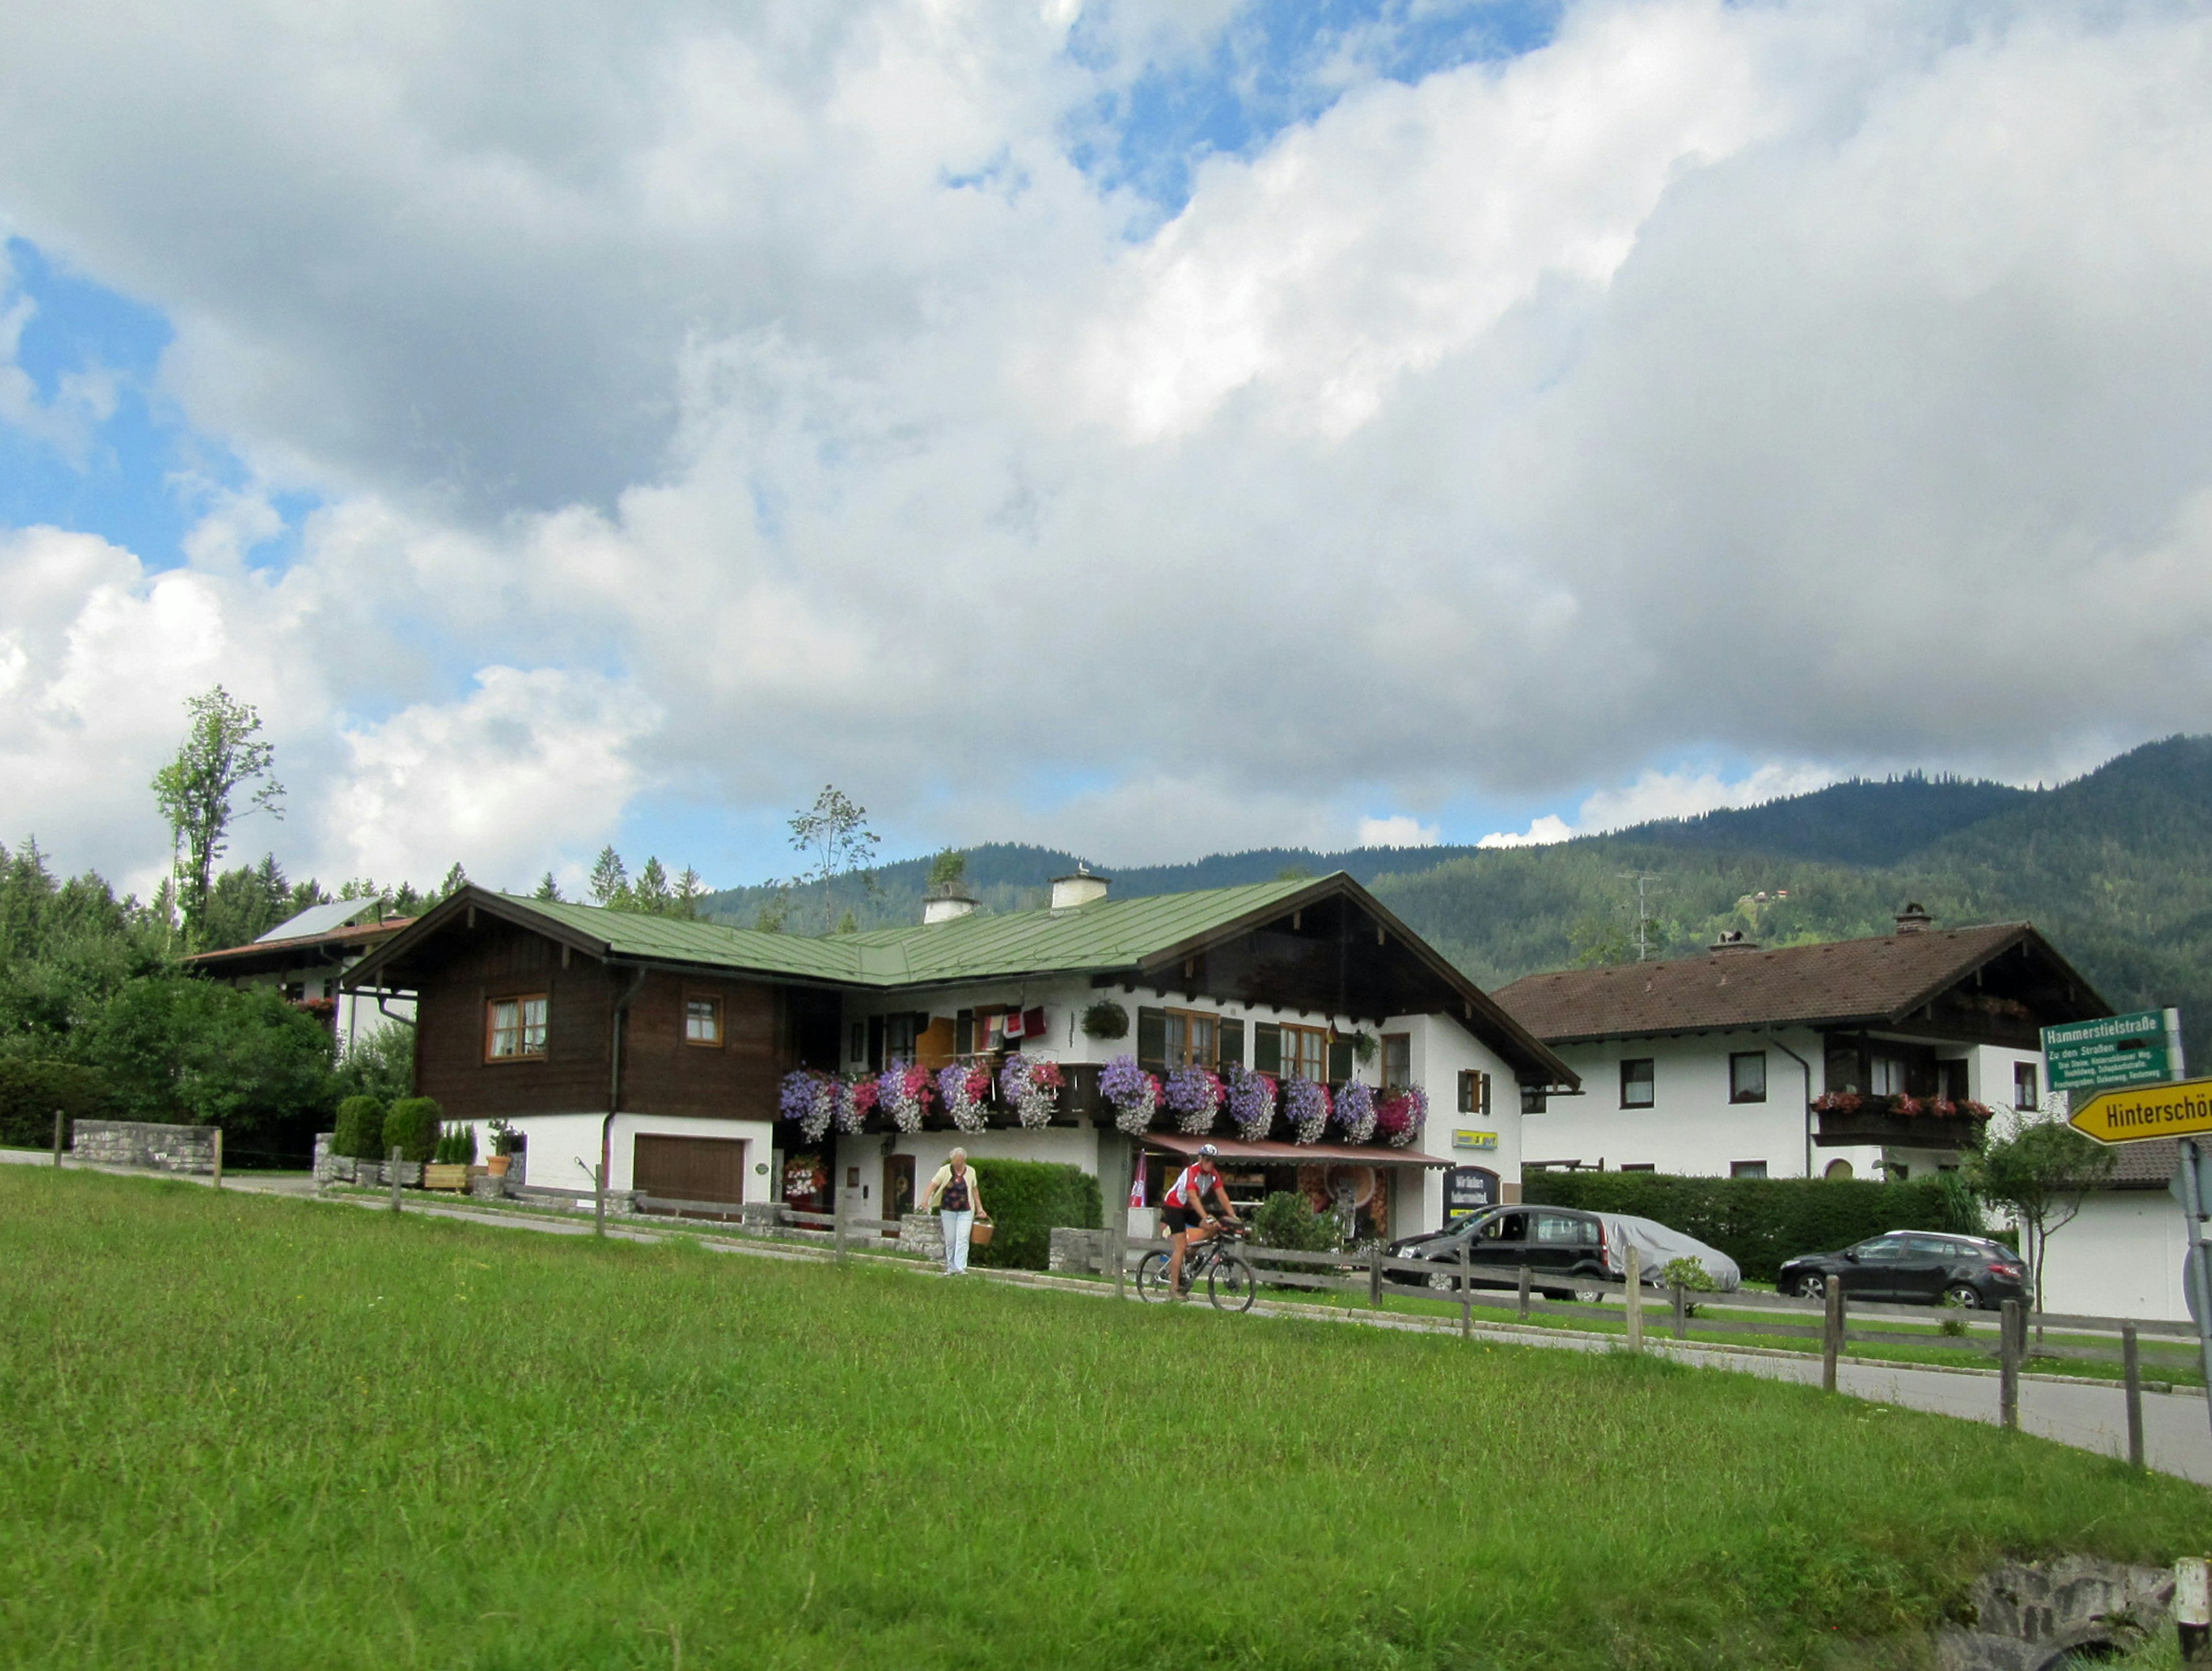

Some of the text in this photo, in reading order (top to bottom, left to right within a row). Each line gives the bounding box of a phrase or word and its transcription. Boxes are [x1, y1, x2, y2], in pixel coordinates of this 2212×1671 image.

[2047, 1016, 2157, 1044] Hammerstielstraße
[2048, 1044, 2115, 1060] Zu den Straßen
